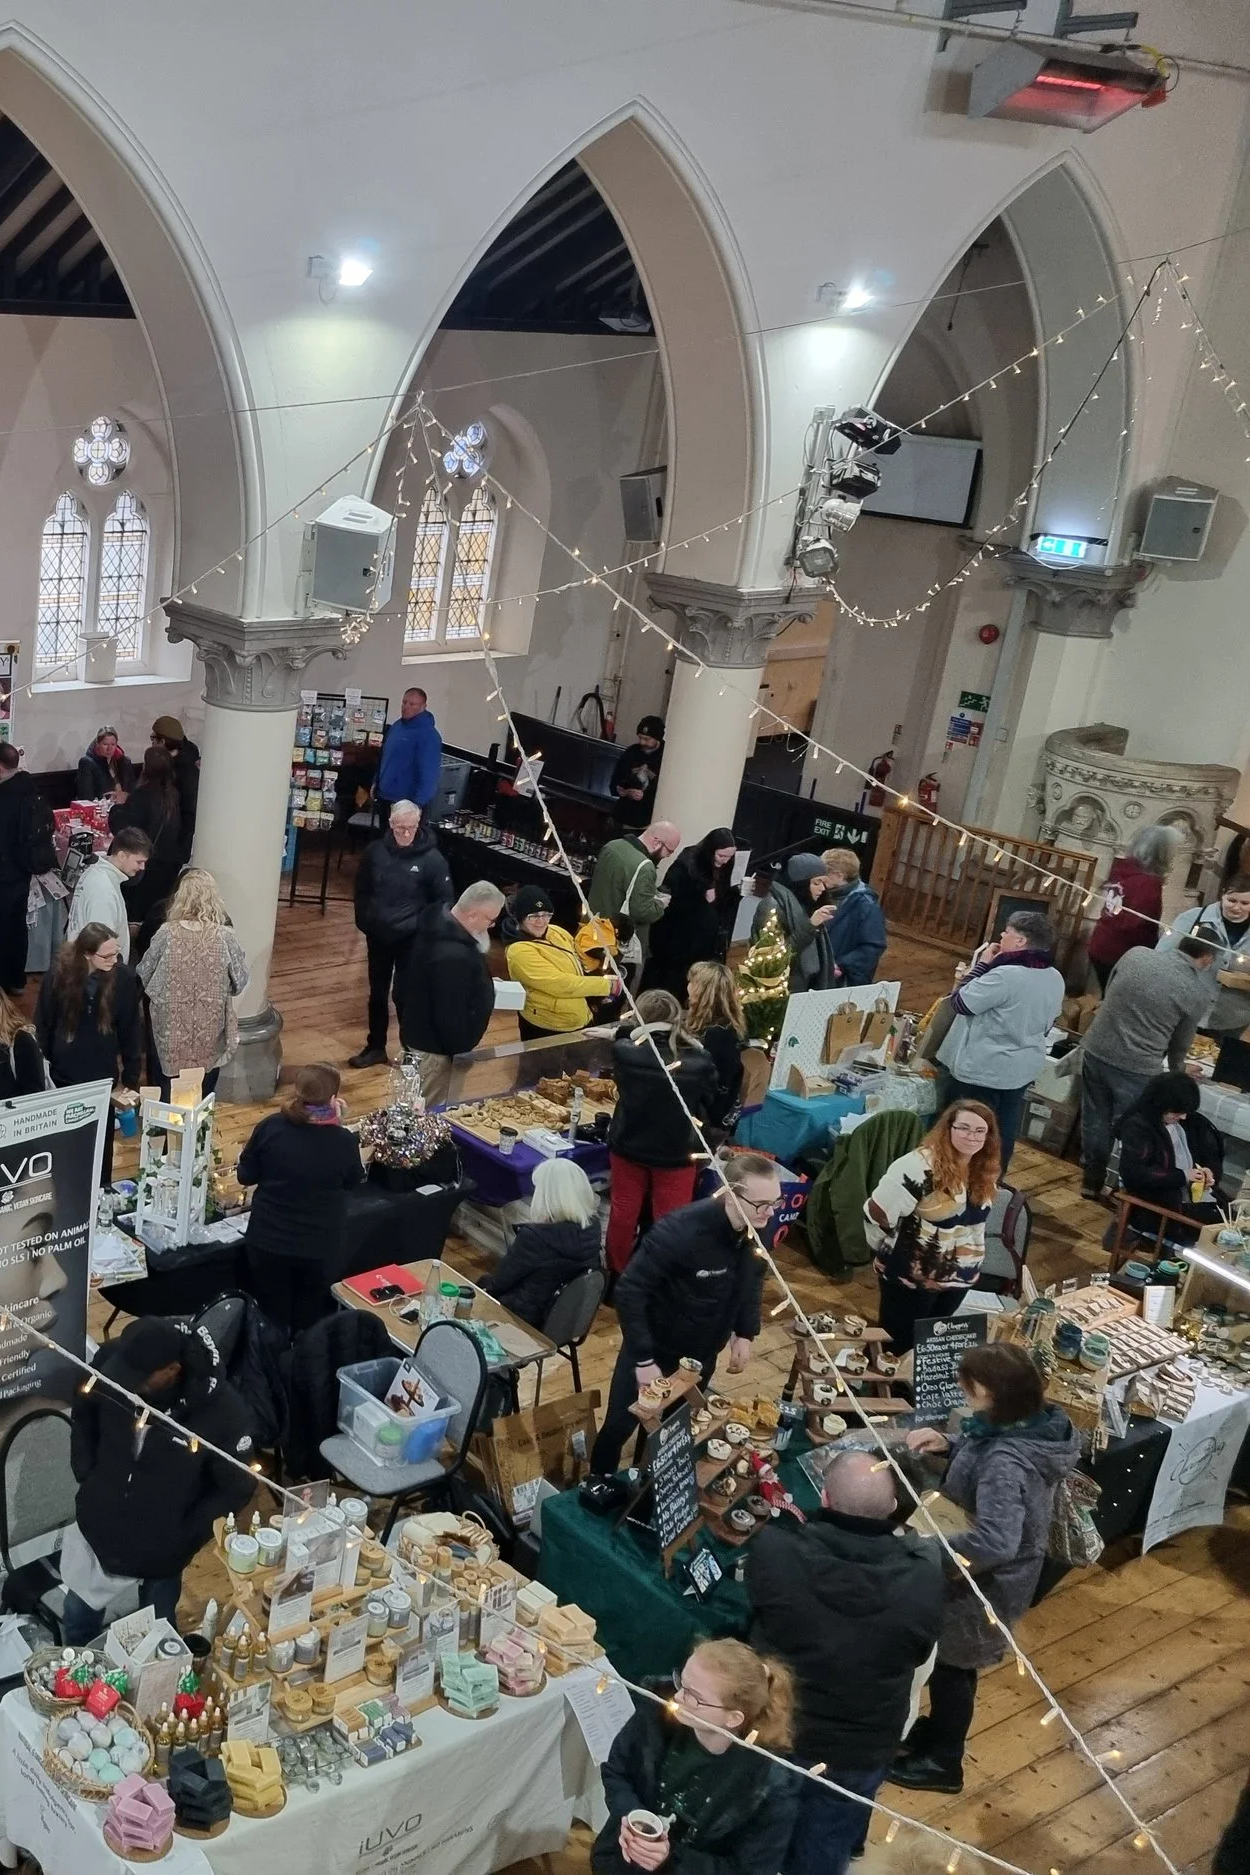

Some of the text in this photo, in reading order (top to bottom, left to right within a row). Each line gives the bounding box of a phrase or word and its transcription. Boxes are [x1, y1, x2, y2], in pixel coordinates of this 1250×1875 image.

[814, 826, 830, 836] EXIT
[815, 818, 832, 829] FIRE
[14, 1109, 58, 1126] HANDMADE
[14, 1129, 22, 1137] IN
[25, 1120, 58, 1135] BRITAIN
[14, 1199, 29, 1210] VEGAN
[30, 1192, 53, 1205] SKINCARE
[10, 1236, 42, 1251] TESTED
[44, 1232, 59, 1241] ON
[11, 1252, 25, 1263] SLS
[32, 1246, 46, 1258] NO
[48, 1241, 72, 1254] PALM
[74, 1236, 86, 1246] OIL
[21, 1310, 53, 1325] Organic
[0, 1349, 30, 1367] Friendly
[922, 1357, 951, 1367] Festive
[2, 1362, 37, 1381] Certified
[921, 1372, 949, 1381] Hazelnut
[3, 1379, 42, 1398] Packaging
[921, 1382, 938, 1392] Oreo
[780, 1404, 797, 1415] £25
[922, 1400, 942, 1408] Choc
[672, 1462, 692, 1482] Bakewell
[663, 1504, 690, 1534] Fab Fudge
[664, 1513, 694, 1546] Cool Caramel
